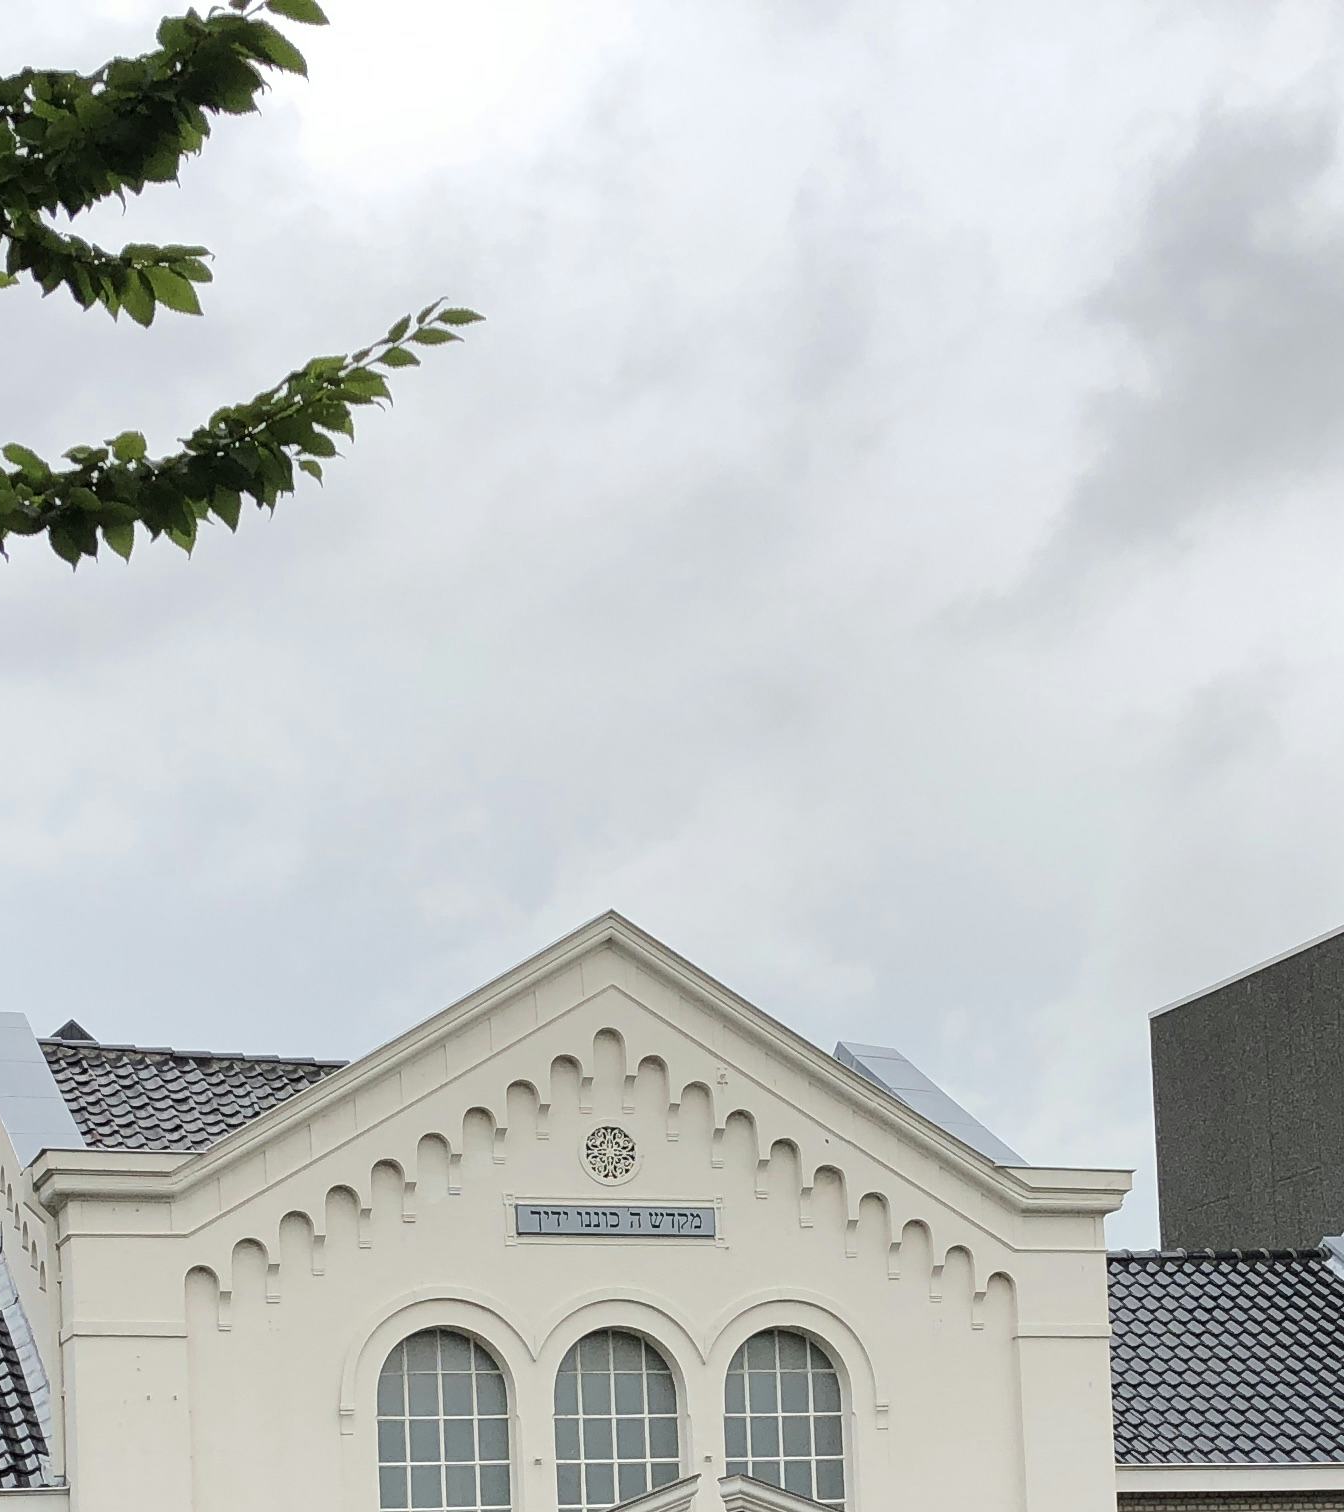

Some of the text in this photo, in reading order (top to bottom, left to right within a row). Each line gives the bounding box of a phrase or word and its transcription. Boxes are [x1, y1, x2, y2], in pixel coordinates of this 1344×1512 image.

[530, 1210, 569, 1232] ידיך
[576, 1211, 620, 1229] כוננו
[648, 1211, 703, 1233] מקדש
